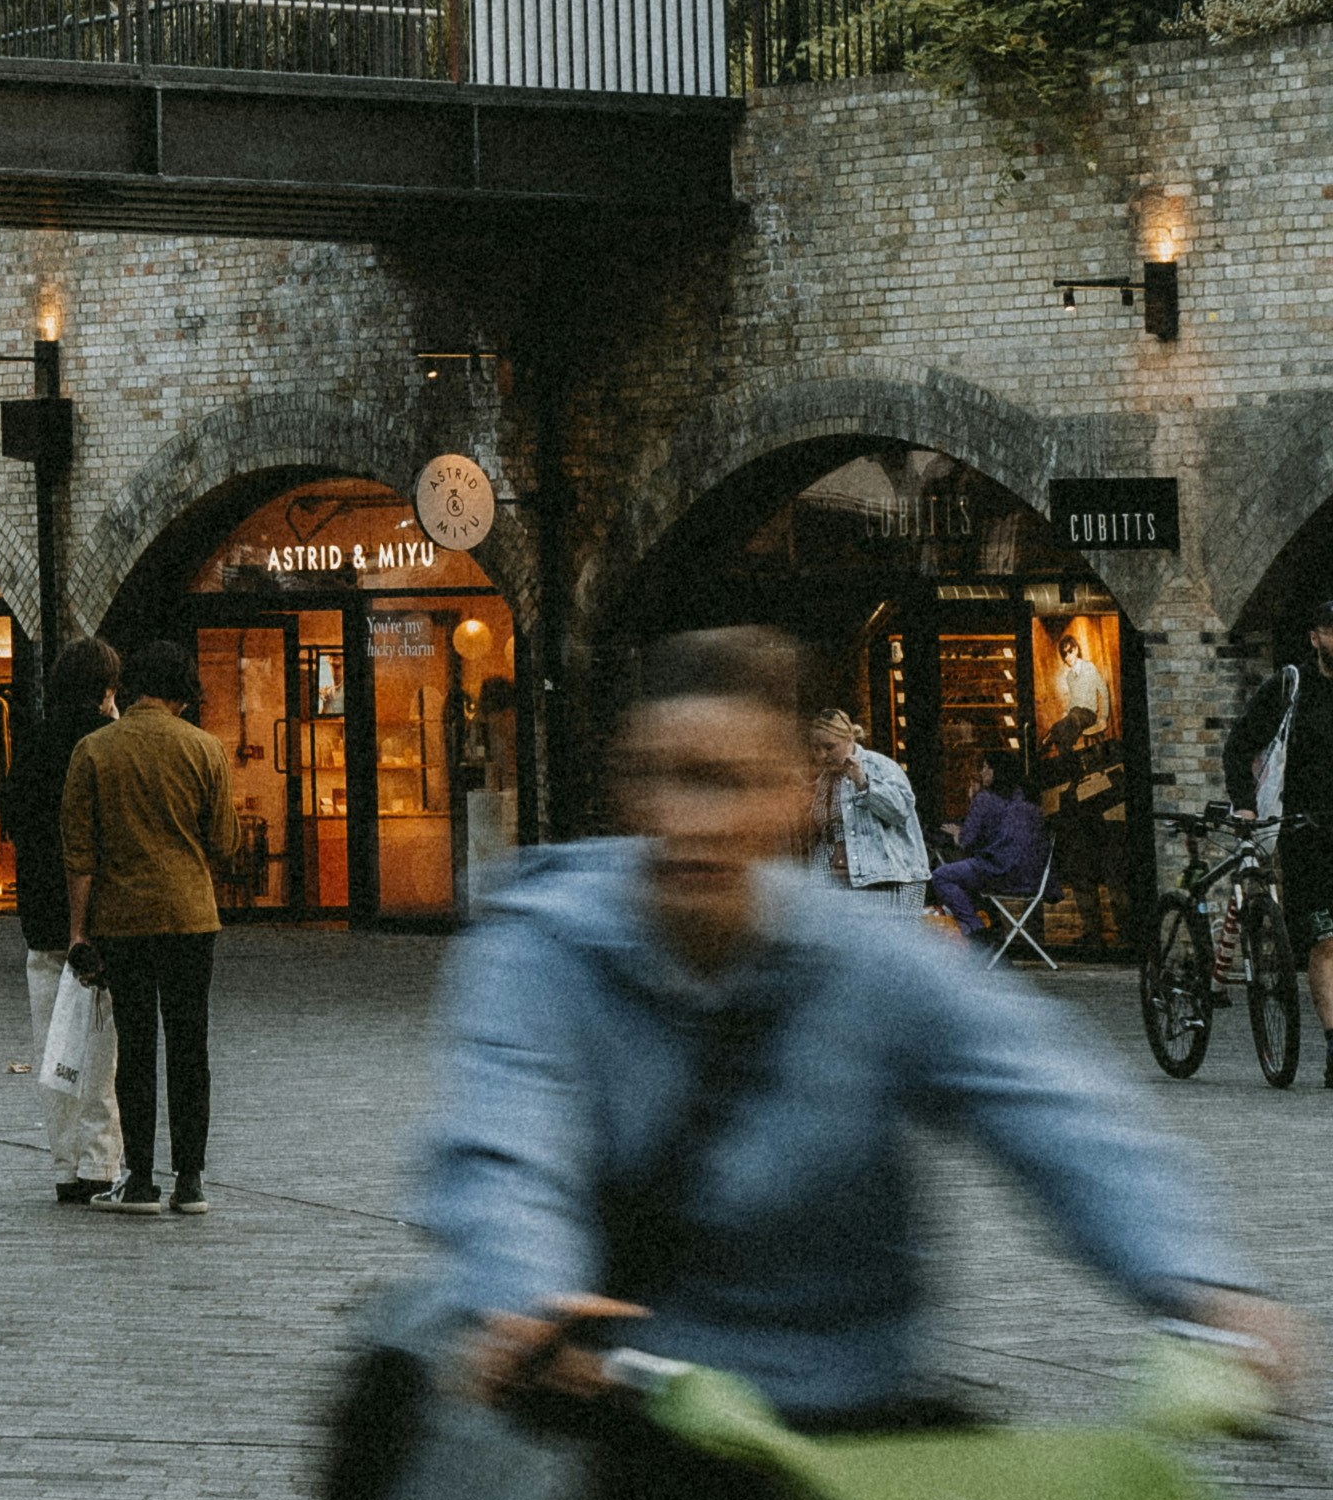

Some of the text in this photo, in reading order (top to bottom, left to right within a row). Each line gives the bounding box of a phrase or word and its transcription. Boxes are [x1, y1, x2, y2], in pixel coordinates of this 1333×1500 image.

[430, 467, 477, 492] ASTRID
[452, 500, 460, 511] &
[866, 495, 970, 537] CUBITTS
[437, 516, 479, 538] MIYU
[1071, 513, 1155, 541] CUBITTS
[267, 542, 434, 571] ASTRID & MIYU
[366, 616, 423, 640] You're my
[367, 637, 435, 664] lucky charm
